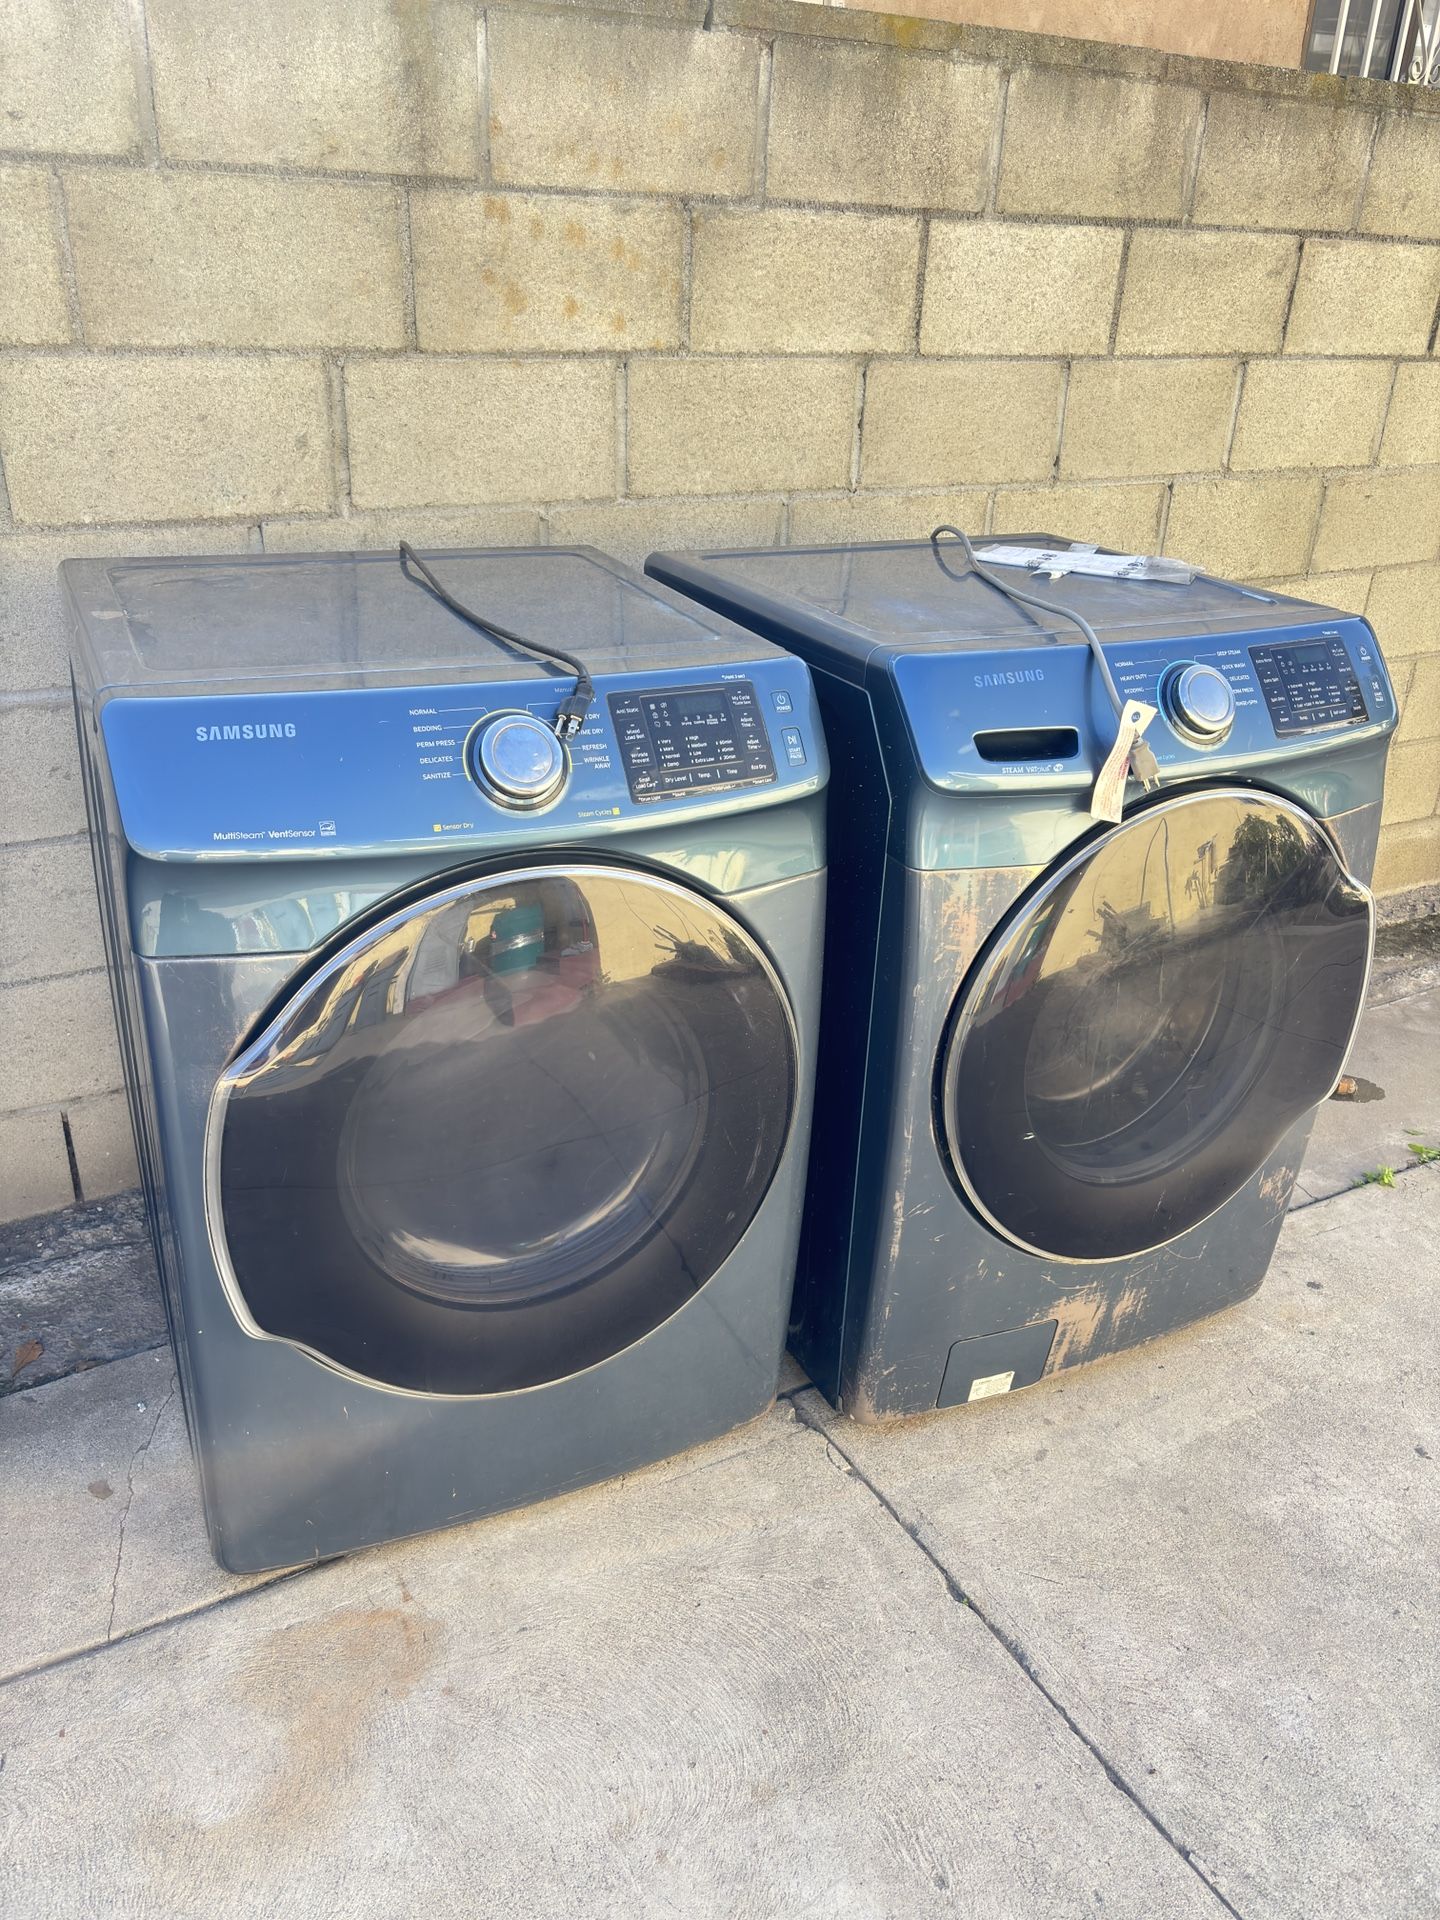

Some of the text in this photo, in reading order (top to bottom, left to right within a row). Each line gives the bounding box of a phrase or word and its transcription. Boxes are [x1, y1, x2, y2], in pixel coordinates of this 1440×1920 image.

[974, 669, 1045, 688] SAMSUNG
[409, 708, 437, 716] NORMAL
[196, 723, 296, 742] SAMSUNG
[413, 725, 442, 733] BEDDING
[420, 756, 453, 764] DELICATES
[1002, 766, 1023, 774] STEAM
[422, 772, 452, 780] SANITIZE
[595, 809, 612, 817] Cycles
[442, 822, 474, 831] Sensor Dry
[268, 829, 316, 839] VentSensor
